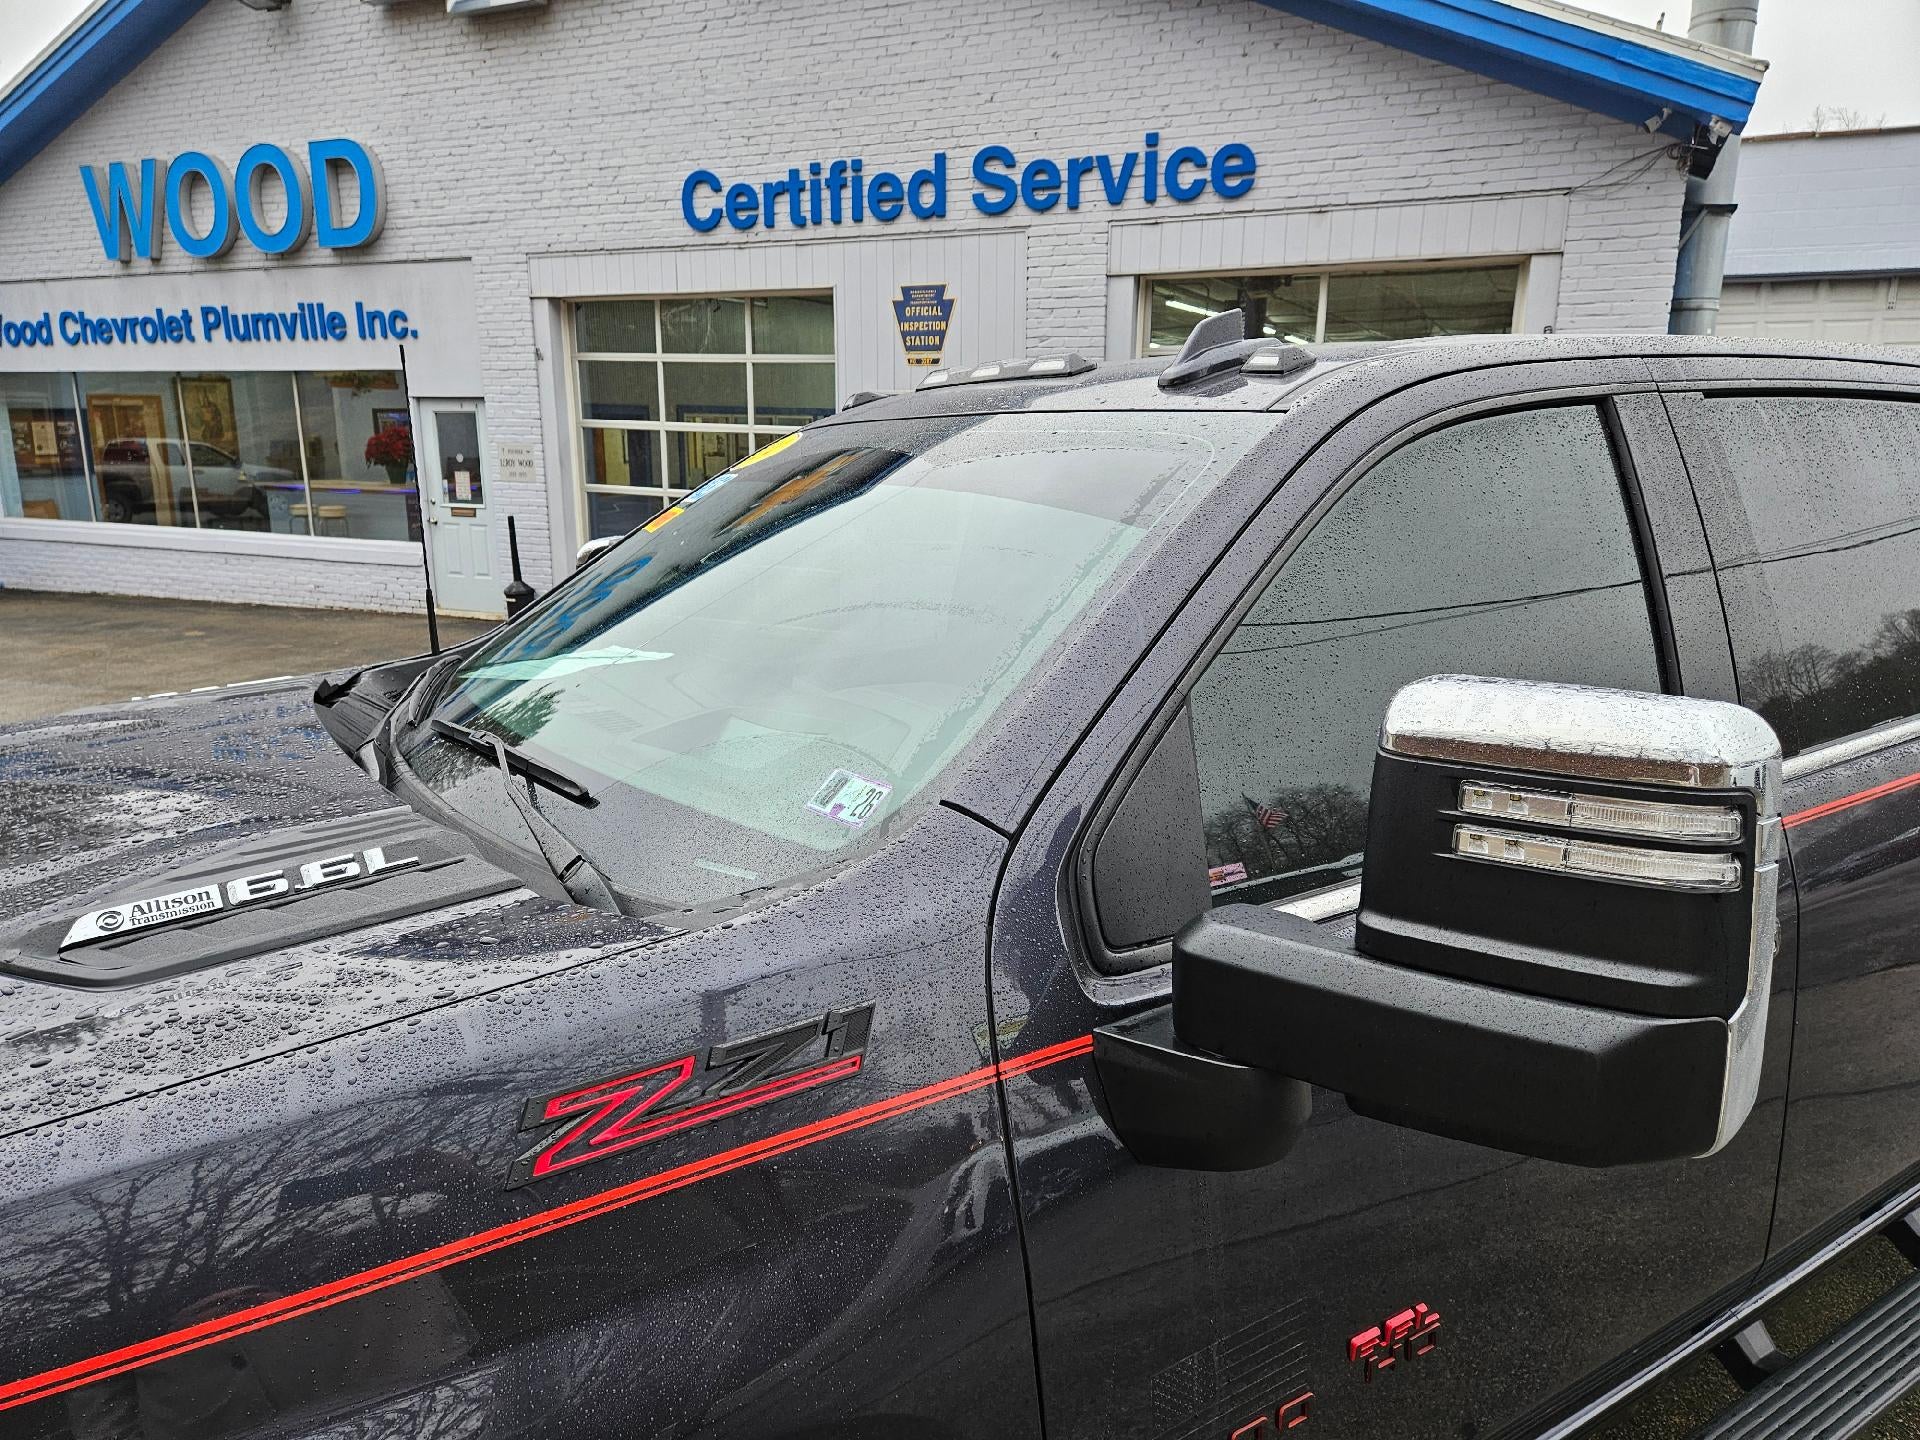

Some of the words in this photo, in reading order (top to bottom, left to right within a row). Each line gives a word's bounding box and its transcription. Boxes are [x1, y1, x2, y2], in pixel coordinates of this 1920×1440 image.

[79, 138, 382, 261] WOOD
[681, 152, 947, 232] Certified
[971, 132, 1257, 215] Service
[0, 312, 54, 348] ood
[58, 308, 196, 346] Chevrolet
[200, 302, 347, 342] Plumville
[355, 302, 418, 341] Inc.
[900, 320, 947, 331] INSPECTION
[905, 305, 943, 317] OFFICIAL
[905, 335, 940, 346] STATION
[226, 847, 420, 907] 6.6L
[128, 889, 213, 918] Allison
[129, 900, 216, 927] Transmission
[495, 1000, 877, 1191] Z71
